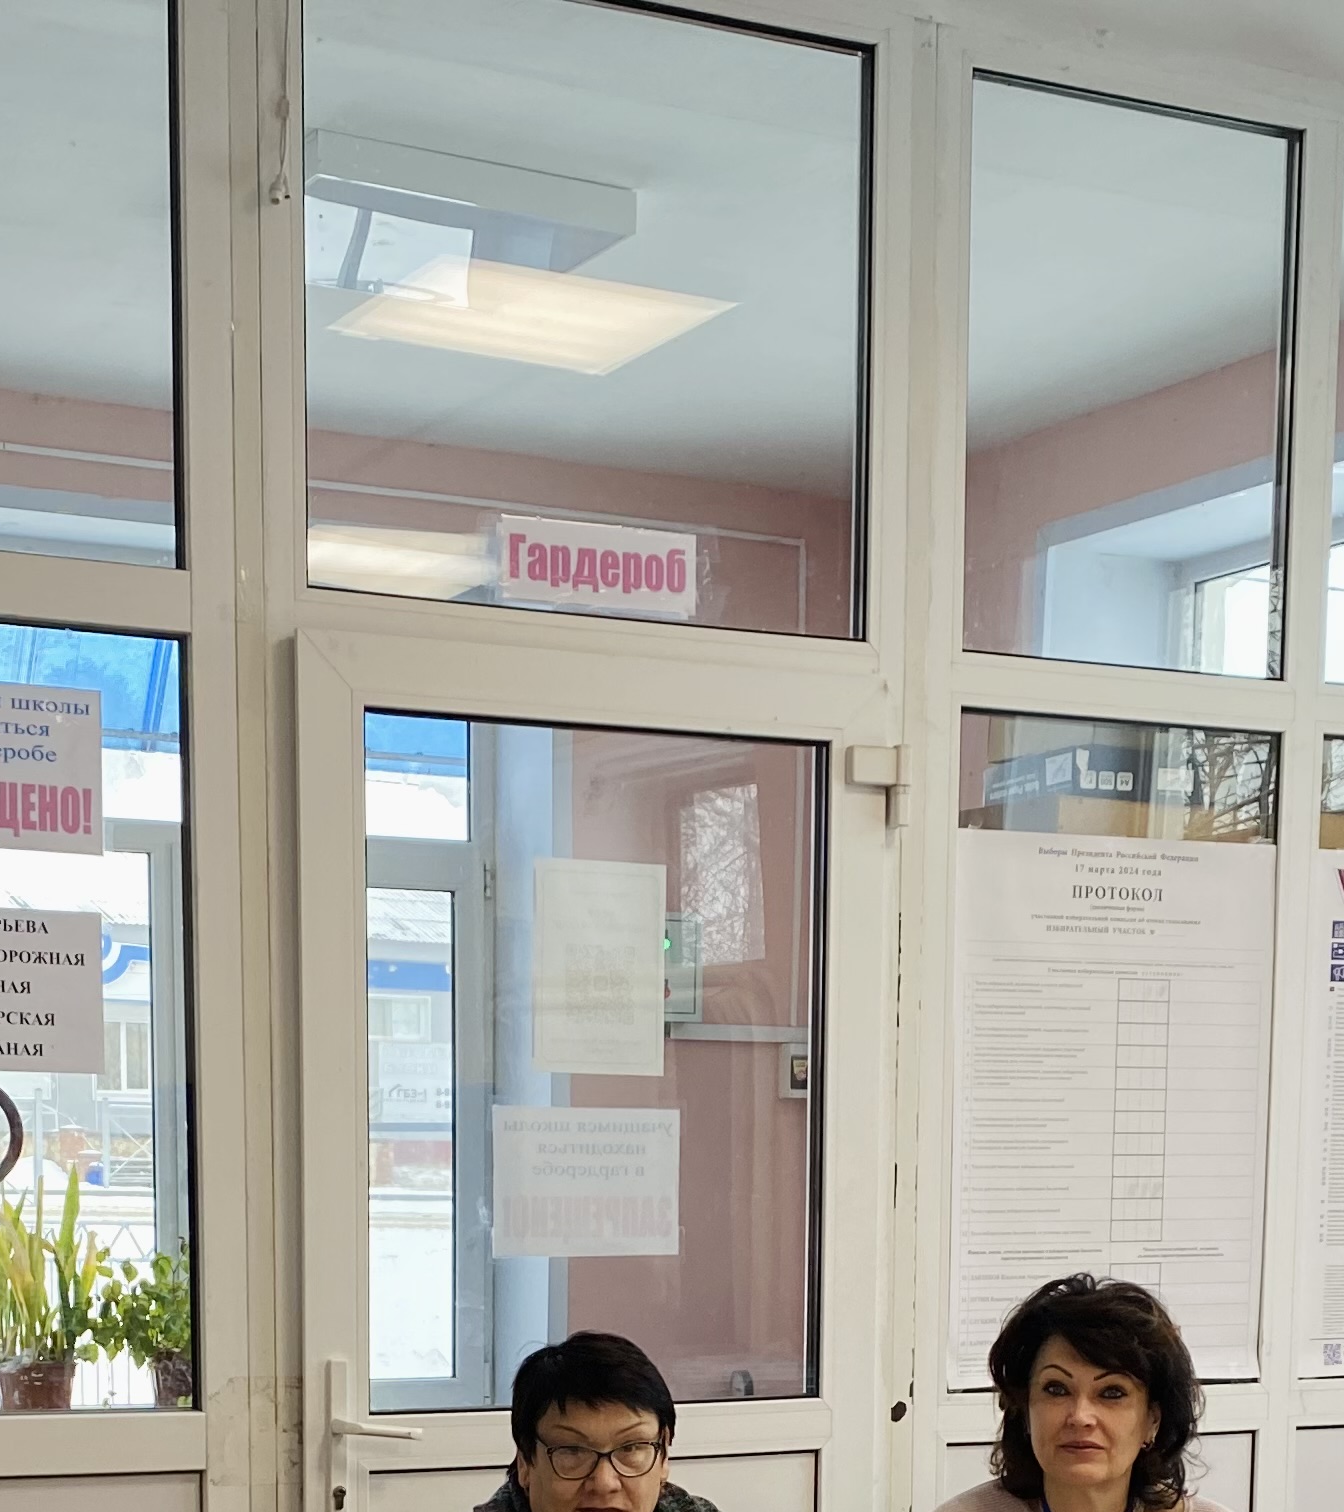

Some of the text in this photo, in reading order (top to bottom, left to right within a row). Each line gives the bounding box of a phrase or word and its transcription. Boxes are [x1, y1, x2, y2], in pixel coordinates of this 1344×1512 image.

[509, 533, 686, 594] Гардероб
[11, 697, 90, 716] школы
[1075, 864, 1085, 873] 17
[1088, 866, 1115, 876] марта
[1118, 866, 1139, 875] 2024
[1072, 885, 1163, 902] ПРОТОКОЛ
